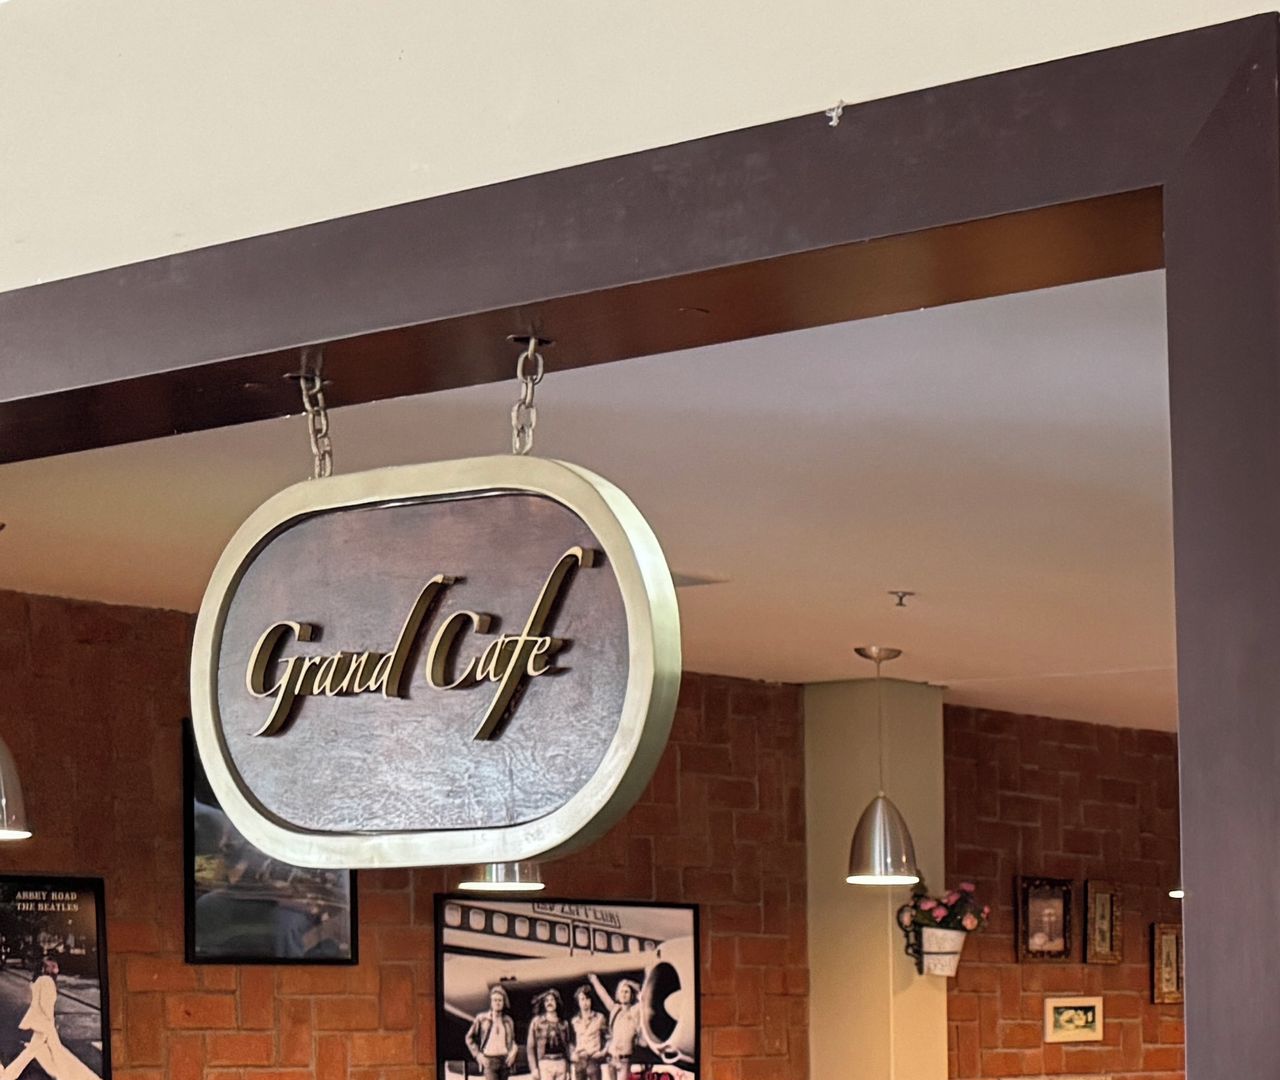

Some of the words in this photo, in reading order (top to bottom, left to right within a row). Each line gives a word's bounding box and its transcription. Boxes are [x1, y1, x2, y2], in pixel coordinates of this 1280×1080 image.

[244, 574, 455, 737] Grand
[16, 891, 47, 900] ABBEY
[52, 892, 77, 900] ROAD
[38, 903, 79, 912] BEATLES
